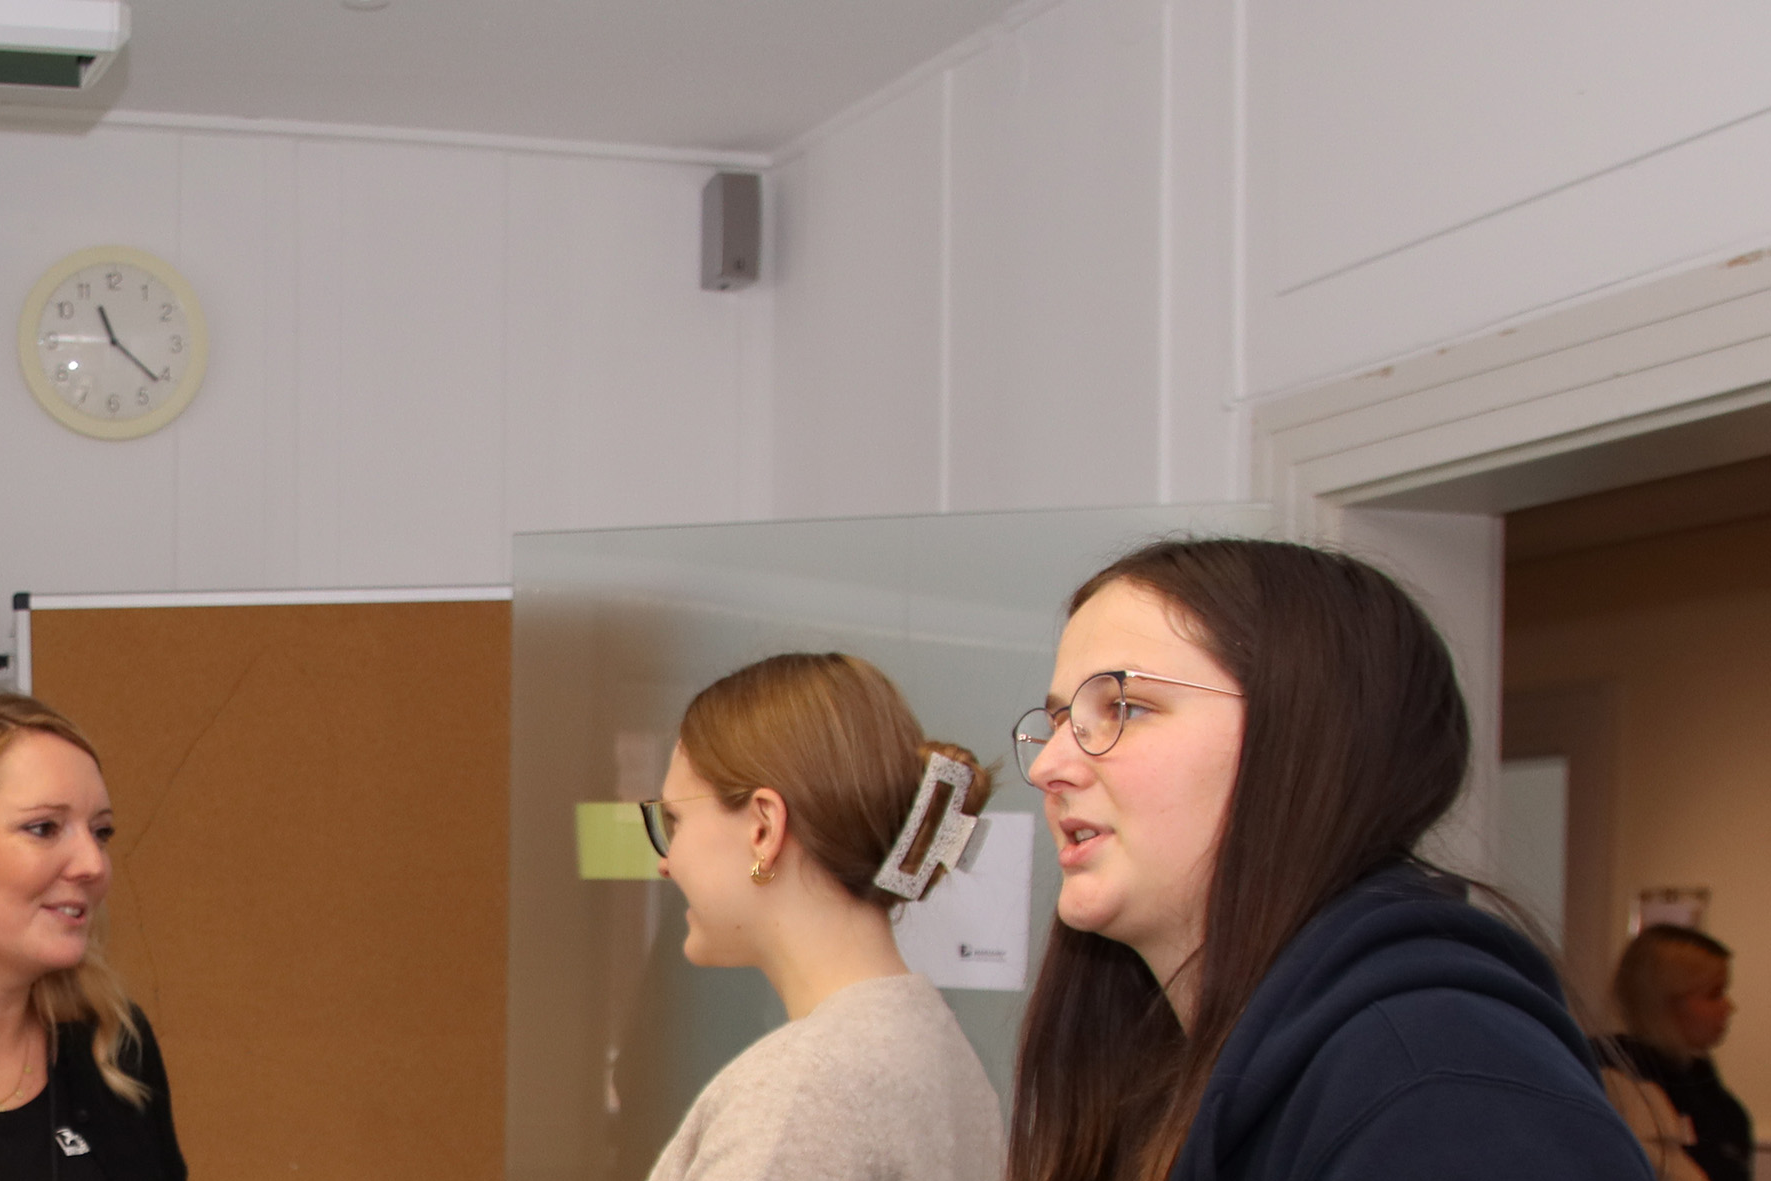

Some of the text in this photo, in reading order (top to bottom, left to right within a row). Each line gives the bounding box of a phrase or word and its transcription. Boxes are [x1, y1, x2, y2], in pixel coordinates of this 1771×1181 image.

[77, 283, 91, 299] 11
[105, 271, 123, 291] 12
[140, 284, 149, 302] 1
[56, 300, 74, 320] 10
[159, 302, 173, 322] 2
[170, 334, 183, 354] 3
[56, 363, 69, 382] 8
[159, 366, 171, 382] 4
[106, 393, 121, 413] 6
[138, 386, 150, 406] 5
